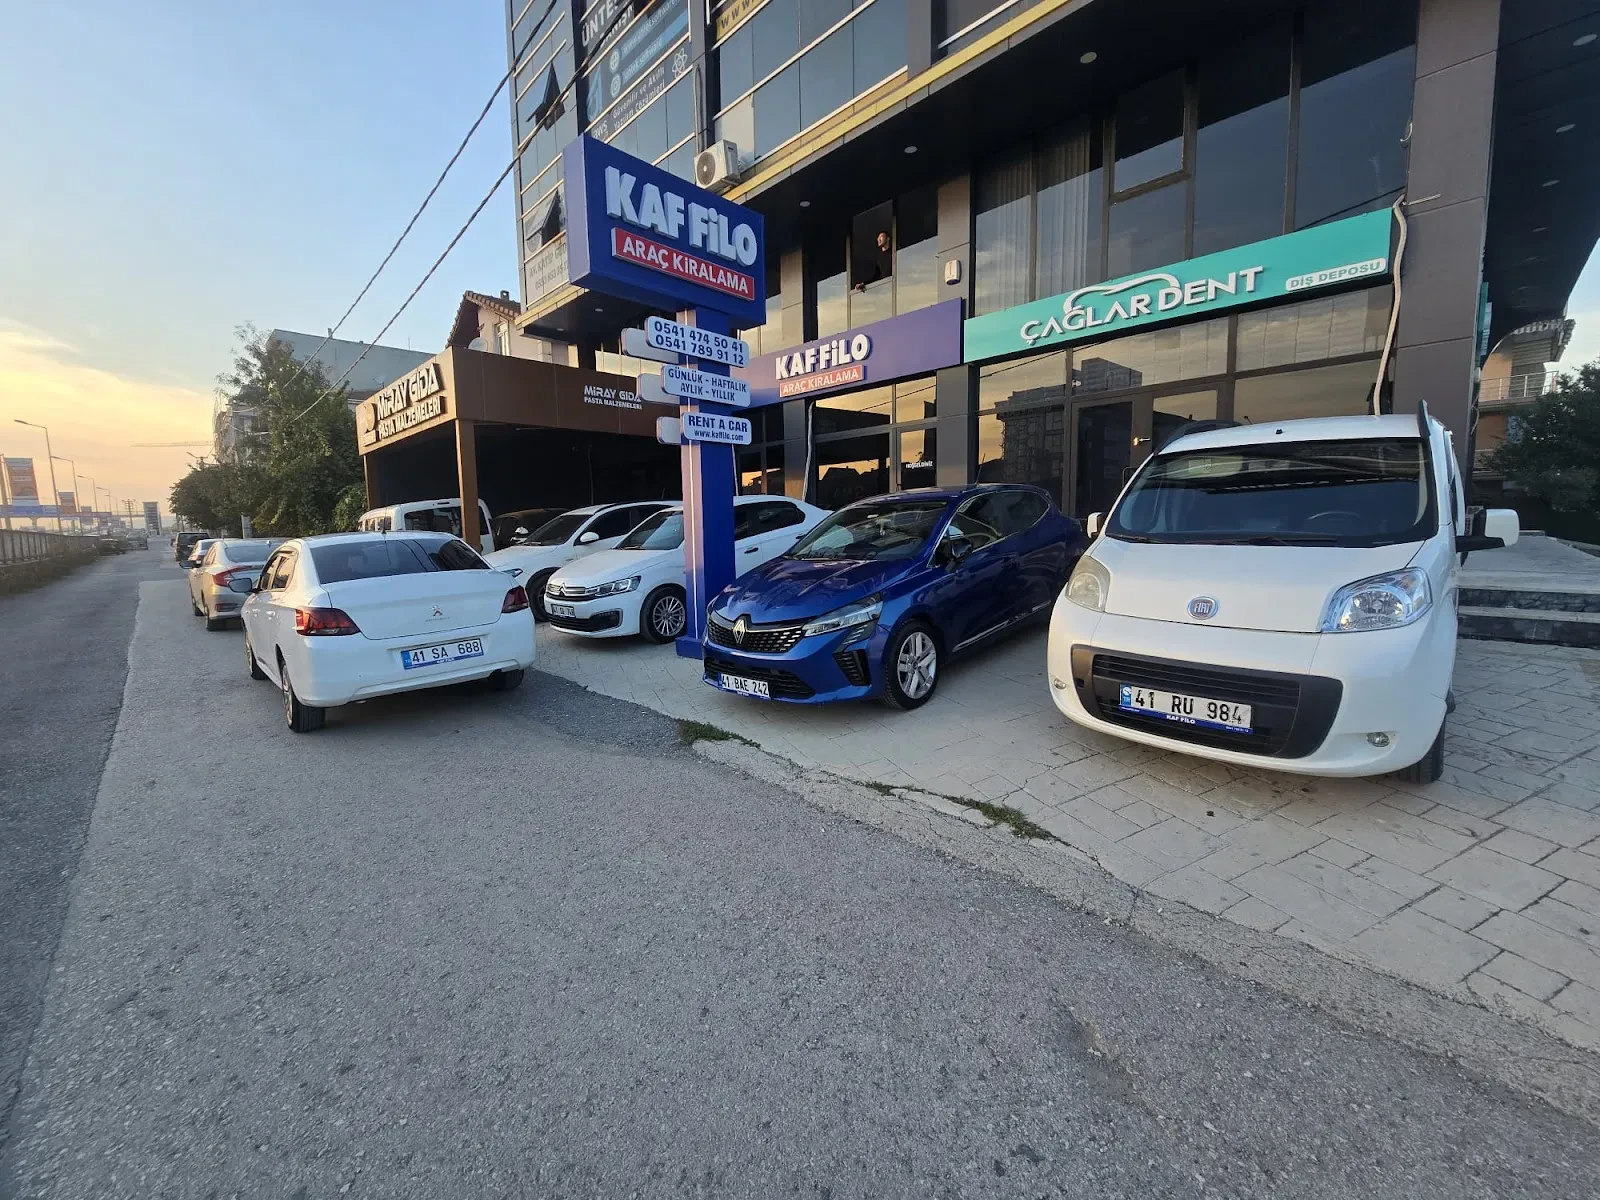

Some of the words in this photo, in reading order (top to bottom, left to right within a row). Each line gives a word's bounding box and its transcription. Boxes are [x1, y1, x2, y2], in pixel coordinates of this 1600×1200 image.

[605, 165, 684, 240] KAF
[623, 236, 669, 269] ARAÇ
[1318, 261, 1381, 282] DEPOSU
[1157, 266, 1264, 312] DENT
[654, 320, 685, 338] 0541
[689, 330, 710, 344] 474
[714, 336, 728, 349] 50
[731, 341, 743, 353] 41
[655, 334, 686, 351] 0541
[691, 342, 713, 357] 789
[717, 350, 729, 361] 91
[733, 354, 744, 365] 12
[775, 348, 816, 380] KAF
[408, 363, 440, 403] GIDA
[668, 367, 703, 384] GÜNLÜK
[711, 377, 747, 393] HAFTALIK
[783, 380, 807, 395] ARAÇ
[583, 396, 603, 405] PASTA
[619, 390, 642, 403] GIDA
[680, 382, 703, 396] AYLIK
[711, 389, 735, 402] YILLIK
[378, 419, 396, 441] PASTA
[688, 415, 716, 429] RENT
[719, 418, 725, 430] A
[728, 420, 748, 433] CAR
[694, 429, 744, 442] www.kaffilo.com
[1193, 602, 1212, 614] FIAT
[412, 651, 426, 663] 41
[431, 646, 449, 660] SA
[457, 641, 480, 655] 688
[722, 673, 730, 688] 41
[734, 675, 750, 692] BAE
[752, 681, 769, 696] 242
[1135, 689, 1155, 709] 41
[1171, 695, 1194, 715] RU
[1206, 701, 1242, 725] 984
